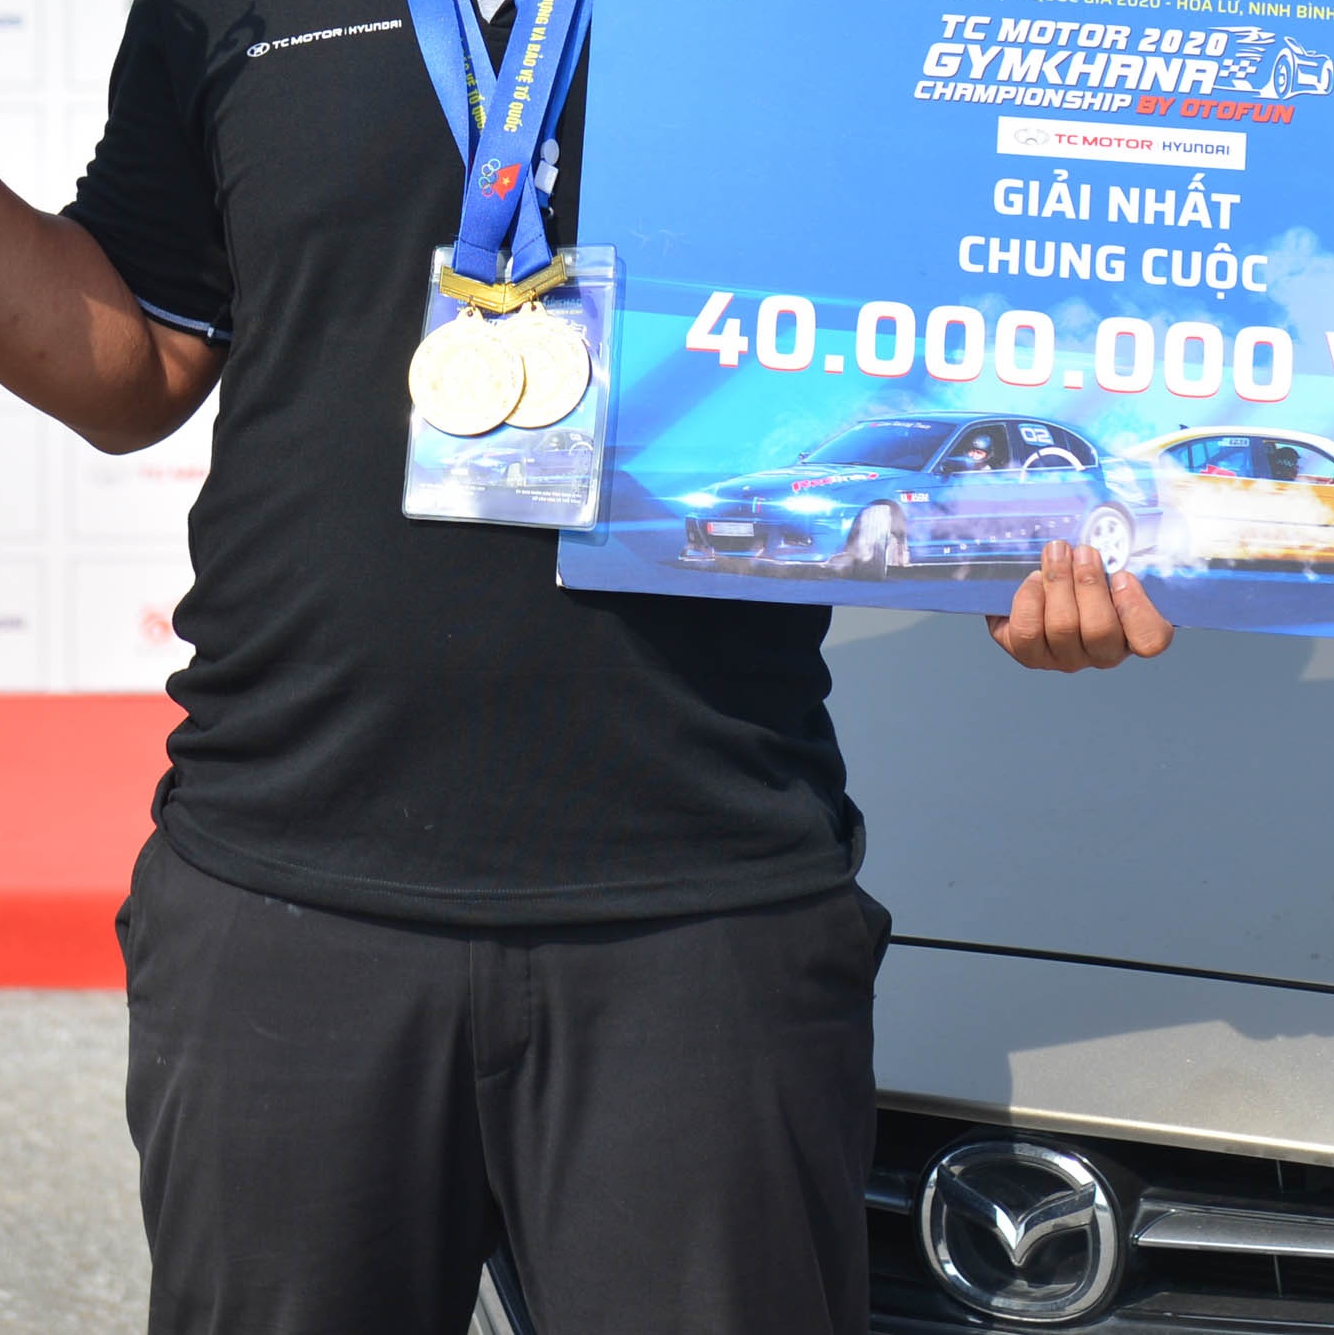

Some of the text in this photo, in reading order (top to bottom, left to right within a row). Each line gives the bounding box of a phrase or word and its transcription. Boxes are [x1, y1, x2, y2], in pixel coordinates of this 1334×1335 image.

[1248, 0, 1291, 18] NINH
[272, 19, 402, 50] TC MOTOR HYUNDAI
[940, 13, 1229, 57] TC MOTOR 2020
[922, 42, 1221, 95] GYMKHANA
[914, 80, 1295, 124] CHAMPIONSHIP BY OTOFUN
[1054, 133, 1230, 155] TC MOTOR HYUNDAI
[993, 171, 1240, 231] GIẢI NHẤT
[959, 236, 1270, 297] CHUNG CUỘC
[685, 291, 1295, 403] 40.000.000
